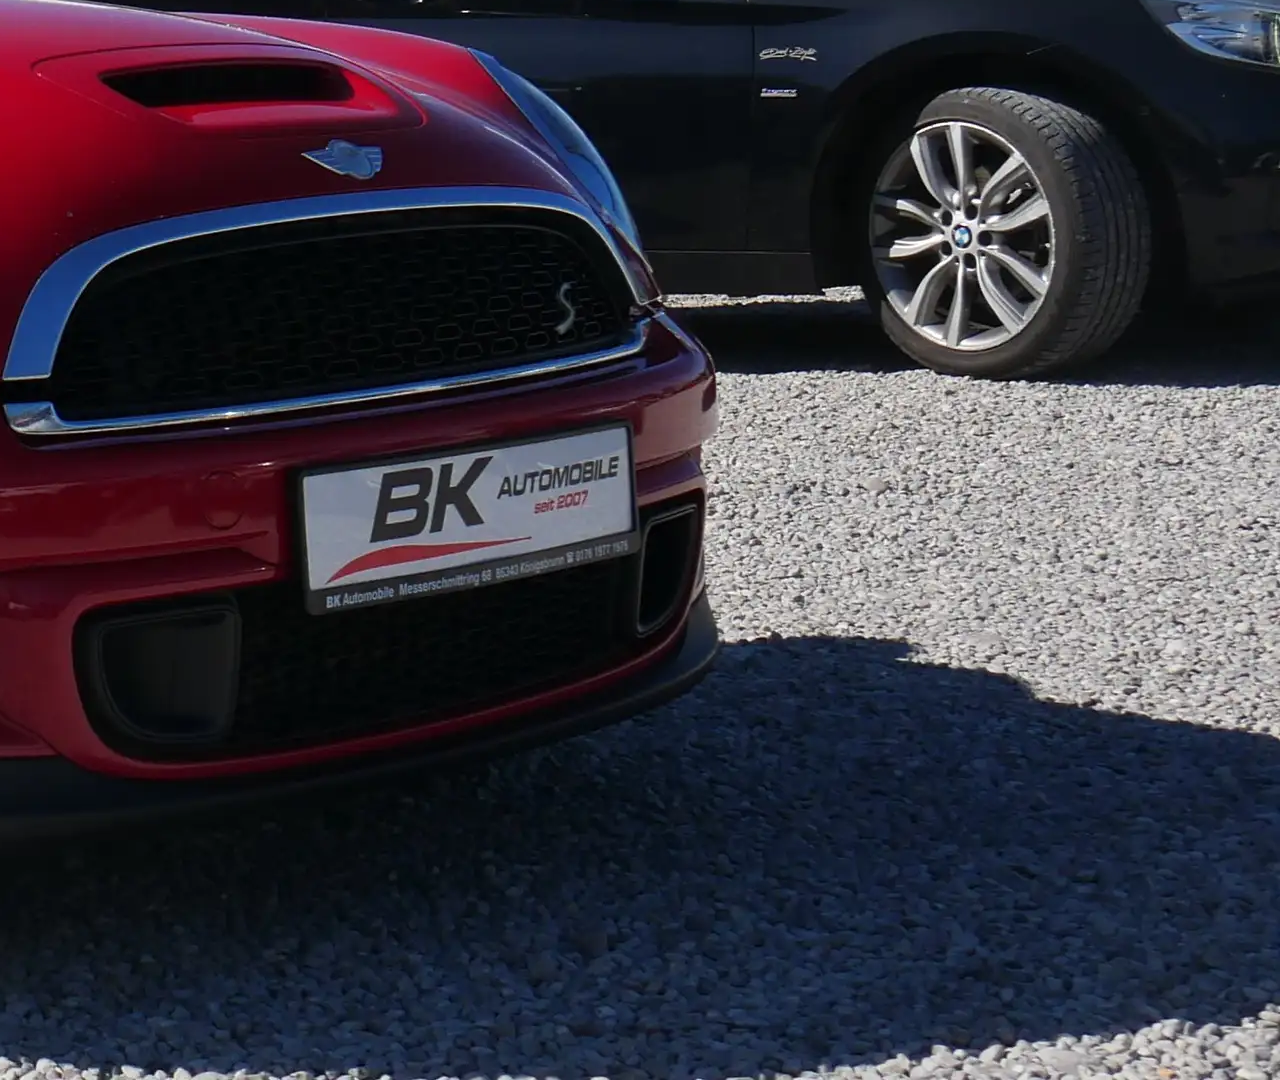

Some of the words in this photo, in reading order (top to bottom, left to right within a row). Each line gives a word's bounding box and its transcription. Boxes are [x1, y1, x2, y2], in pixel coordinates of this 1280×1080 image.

[370, 456, 494, 543] BK
[497, 456, 620, 500] AUTOMOBILE
[534, 497, 555, 515] seit
[556, 490, 589, 508] 2007
[326, 594, 341, 608] BK
[342, 586, 395, 606] Automobile
[399, 570, 481, 596] Messerschmittring
